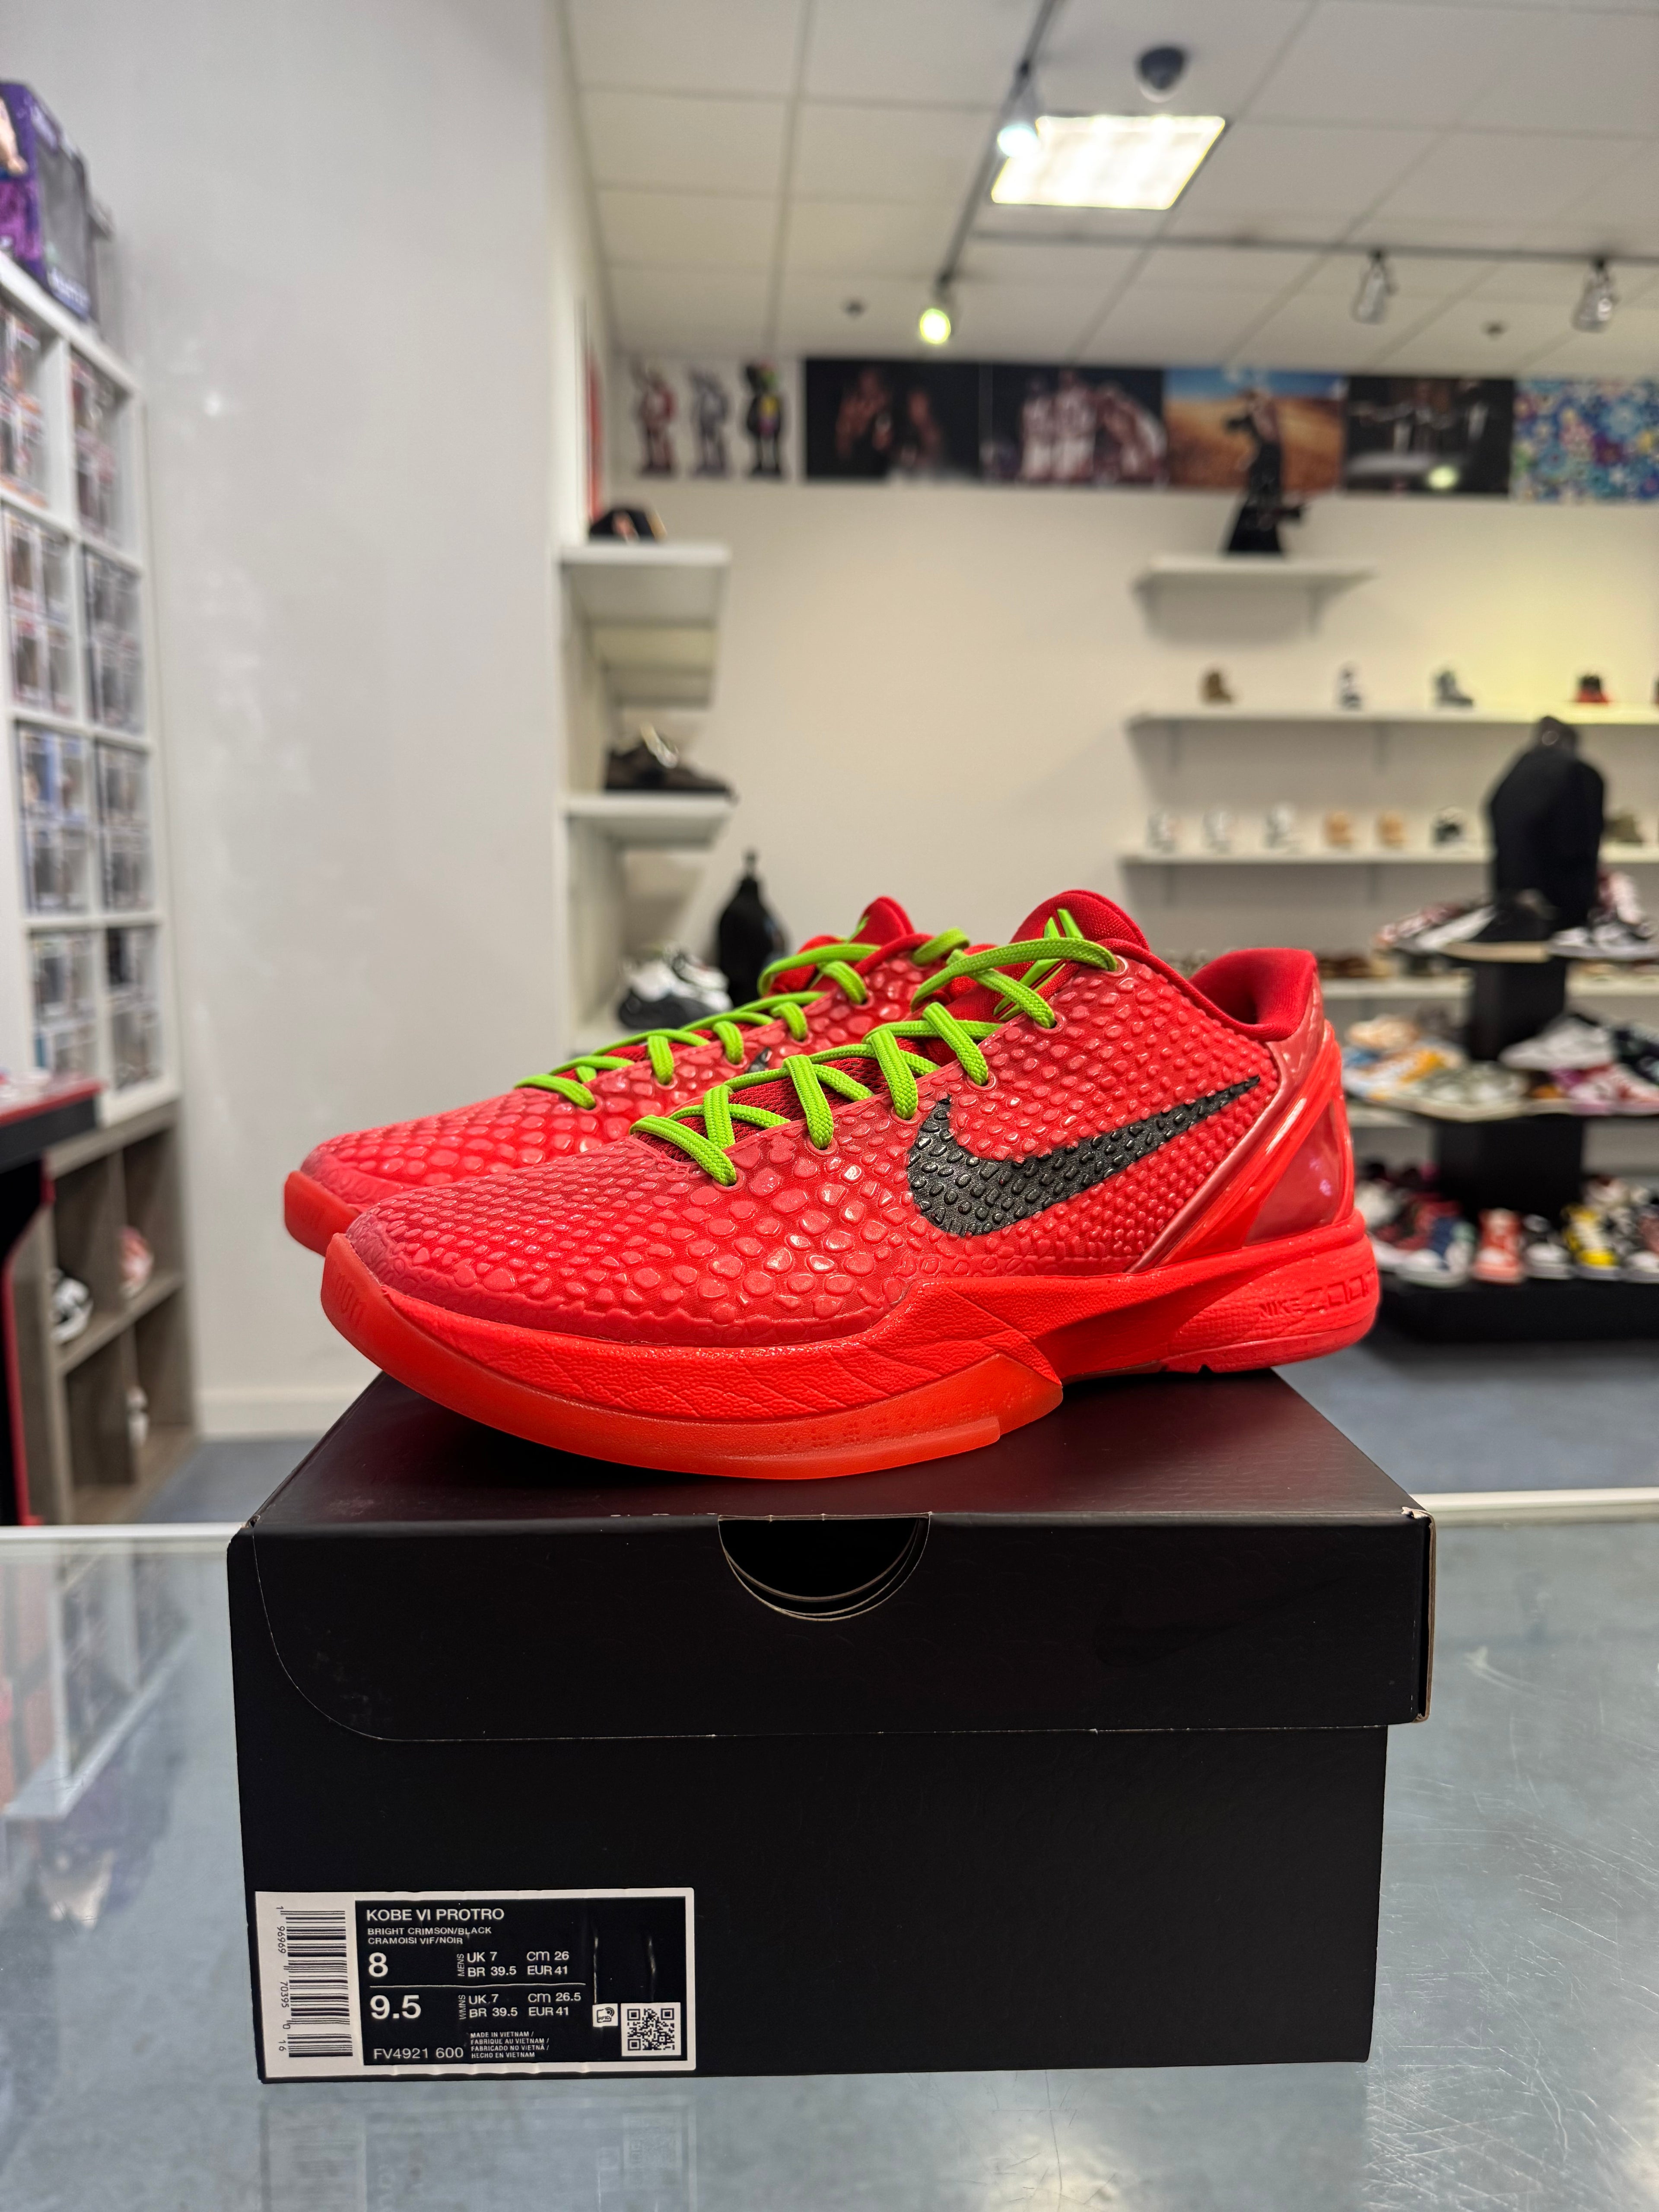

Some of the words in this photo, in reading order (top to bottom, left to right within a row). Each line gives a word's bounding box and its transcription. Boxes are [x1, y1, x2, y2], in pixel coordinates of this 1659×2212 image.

[1259, 1297, 1301, 1317] NIKE
[366, 1909, 413, 1921] KOBE
[416, 1909, 431, 1921] VI
[435, 1908, 505, 1921] PROTRO
[407, 1926, 492, 1935] CRIMSON/BLACK
[277, 1926, 286, 1954] 96969
[419, 1936, 464, 1945] VIF/NOIR
[467, 1951, 486, 1963] UK
[490, 1951, 498, 1961] 7
[526, 1951, 550, 1961] cm
[554, 1951, 570, 1961] 26
[368, 1951, 388, 1977] 8
[457, 1953, 465, 1977] MENS
[467, 1967, 486, 1977] BR
[490, 1966, 517, 1976] 39.5
[527, 1965, 553, 1976] EUR
[554, 1965, 568, 1975] 41
[280, 1981, 289, 2008] 70395
[469, 1994, 486, 2005] UK
[491, 1993, 499, 2003] 7
[528, 1993, 551, 2003] cm
[556, 1992, 582, 2002] 26.5
[370, 1994, 422, 2020] 9.5
[458, 1994, 467, 2020] WMNS
[469, 2008, 487, 2018] BR
[492, 2007, 518, 2017] 39.5
[528, 2006, 554, 2017] EUR
[556, 2006, 569, 2016] 41
[373, 2048, 428, 2059] FV4921
[435, 2047, 464, 2059] 600
